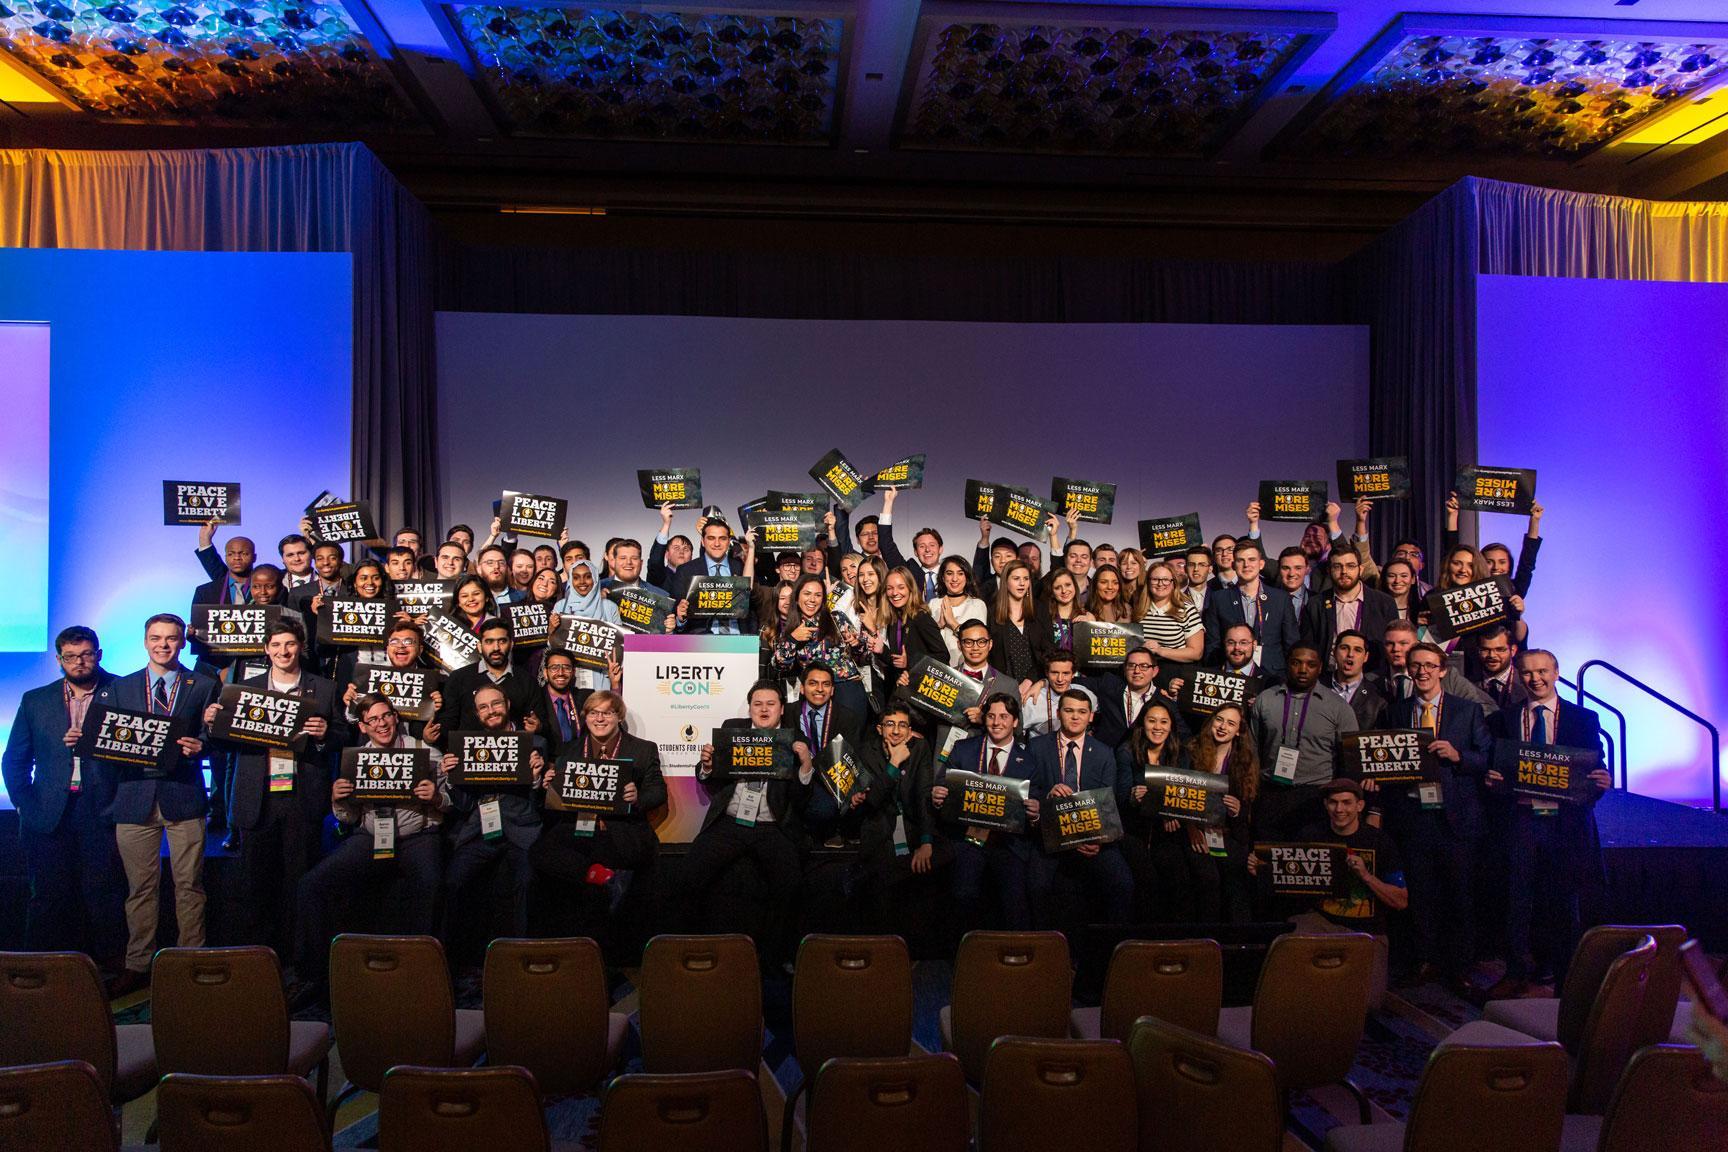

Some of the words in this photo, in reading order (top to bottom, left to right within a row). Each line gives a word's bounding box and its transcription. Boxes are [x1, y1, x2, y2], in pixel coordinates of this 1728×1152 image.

[840, 460, 851, 472] LESS
[825, 470, 853, 496] MISES
[831, 465, 857, 490] MORE
[877, 472, 908, 481] MISES
[1353, 474, 1389, 482] MORE
[653, 483, 685, 492] MORE
[1082, 486, 1100, 494] MARX
[1354, 482, 1390, 492] MISES
[1476, 478, 1517, 489] MISES
[177, 485, 227, 497] PEACE
[654, 491, 686, 500] MISES
[1475, 488, 1516, 498] MORE
[178, 496, 227, 507] LOVE
[514, 497, 557, 512] PEACE
[1010, 493, 1025, 502] LESS
[1026, 498, 1042, 508] MARX
[1066, 492, 1098, 504] MORE
[1275, 495, 1309, 504] MORE
[1473, 498, 1493, 506] MARX
[1494, 500, 1515, 508] LESS
[178, 507, 227, 516] LIBERTY
[1009, 500, 1040, 517] MORE
[1065, 501, 1097, 512] MISES
[1275, 503, 1310, 512] MISES
[318, 512, 360, 523] LIBERTY
[512, 506, 555, 522] LOVE
[1006, 508, 1036, 527] MISES
[320, 520, 362, 533] LOVE
[511, 516, 554, 530] LIBERTY
[765, 524, 798, 533] MORE
[323, 529, 366, 541] PEACE
[766, 533, 798, 541] MISES
[1153, 529, 1185, 540] MORE
[1154, 537, 1187, 548] MISES
[395, 584, 443, 593] PEACE
[1442, 580, 1498, 606] PEACE
[400, 595, 442, 605] OVE
[622, 590, 637, 600] LESS
[638, 595, 656, 606] MARX
[699, 591, 733, 600] MORE
[332, 601, 385, 613] PEACE
[510, 604, 546, 615] PEACE
[620, 598, 653, 618] MORE
[698, 600, 732, 609] MISES
[1448, 592, 1502, 617] LOVE
[208, 609, 265, 622] PEACE
[333, 613, 385, 626] LOVE
[512, 614, 549, 627] LOVE
[619, 607, 651, 625] MISES
[1450, 603, 1504, 626] LIBERTY
[208, 622, 265, 633] LOVE
[332, 626, 385, 634] LIBERTY
[436, 616, 479, 649] PEACE
[514, 626, 549, 638] LIBERTY
[569, 620, 617, 640] PEACE
[208, 634, 265, 644] LIBERTY
[566, 631, 614, 651] LOVE
[1091, 637, 1126, 647] MORE
[1091, 646, 1126, 657] MISES
[369, 669, 424, 685] PEACE
[656, 666, 724, 680] LIBERTY
[927, 665, 944, 680] LESS
[942, 673, 963, 687] MARX
[921, 674, 960, 700] MORE
[1195, 671, 1245, 691] PEACE
[368, 682, 423, 698] LOVE
[672, 681, 710, 695] CON
[1194, 682, 1244, 701] LOVE
[238, 691, 300, 714] PEACE
[391, 698, 422, 708] ERTY
[917, 685, 955, 708] MISES
[234, 705, 297, 727] LOVE
[103, 712, 170, 734] PEACE
[231, 718, 293, 737] LIBERTY
[99, 724, 165, 747] LOVE
[1358, 733, 1418, 748] PEACE
[96, 738, 162, 757] LIBERTY
[464, 736, 518, 749] PEACE
[464, 749, 518, 761] LOVE
[733, 747, 773, 756] MORE
[1360, 747, 1420, 762] LOVE
[1519, 749, 1541, 759] LESS
[1544, 752, 1570, 762] MARX
[357, 753, 413, 766] PEACE
[732, 757, 773, 766] MISES
[356, 766, 413, 779] LOVE
[464, 762, 518, 772] LIBERTY
[565, 762, 619, 778] PEACE
[1362, 761, 1421, 773] LIBERTY
[1519, 761, 1569, 778] MORE
[356, 780, 413, 790] LIBERTY
[563, 773, 617, 790] LOVE
[965, 779, 984, 789] LESS
[985, 783, 1008, 792] MARX
[1166, 775, 1182, 783] LESS
[1183, 777, 1207, 787] MARX
[1518, 773, 1569, 789] MISES
[562, 788, 617, 801] LIBERTY
[964, 790, 1006, 804] MORE
[1165, 785, 1206, 801] MORE
[963, 802, 1005, 817] MISES
[1055, 802, 1074, 811] LESS
[1074, 798, 1096, 807] MARX
[1164, 797, 1205, 812] MISES
[1058, 808, 1099, 826] MORE
[1060, 819, 1102, 836] MISES
[1271, 847, 1331, 861] PEACE
[1272, 861, 1332, 874] LOVE
[1273, 875, 1332, 886] LIBERTY
